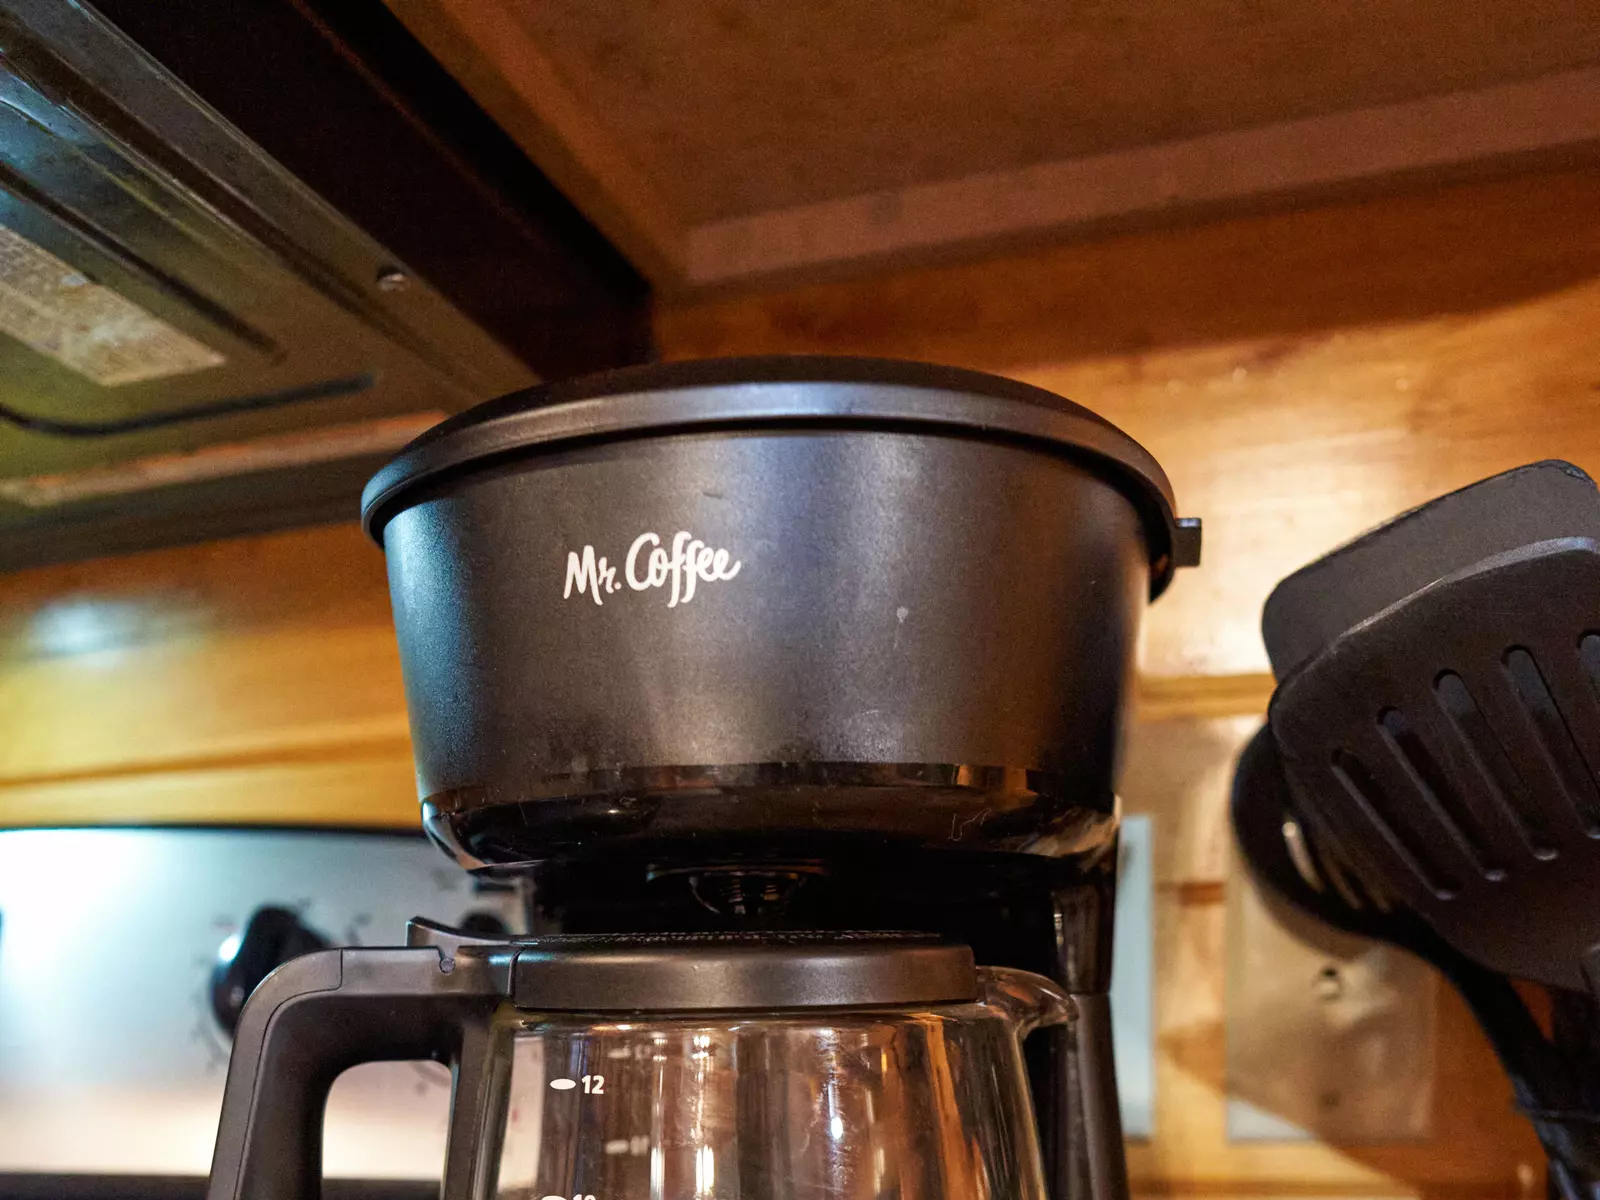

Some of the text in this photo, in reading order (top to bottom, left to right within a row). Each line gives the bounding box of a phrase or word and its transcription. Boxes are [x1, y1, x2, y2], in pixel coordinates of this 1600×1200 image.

[563, 531, 742, 608] Mr. Coffee
[581, 1075, 605, 1095] 12
